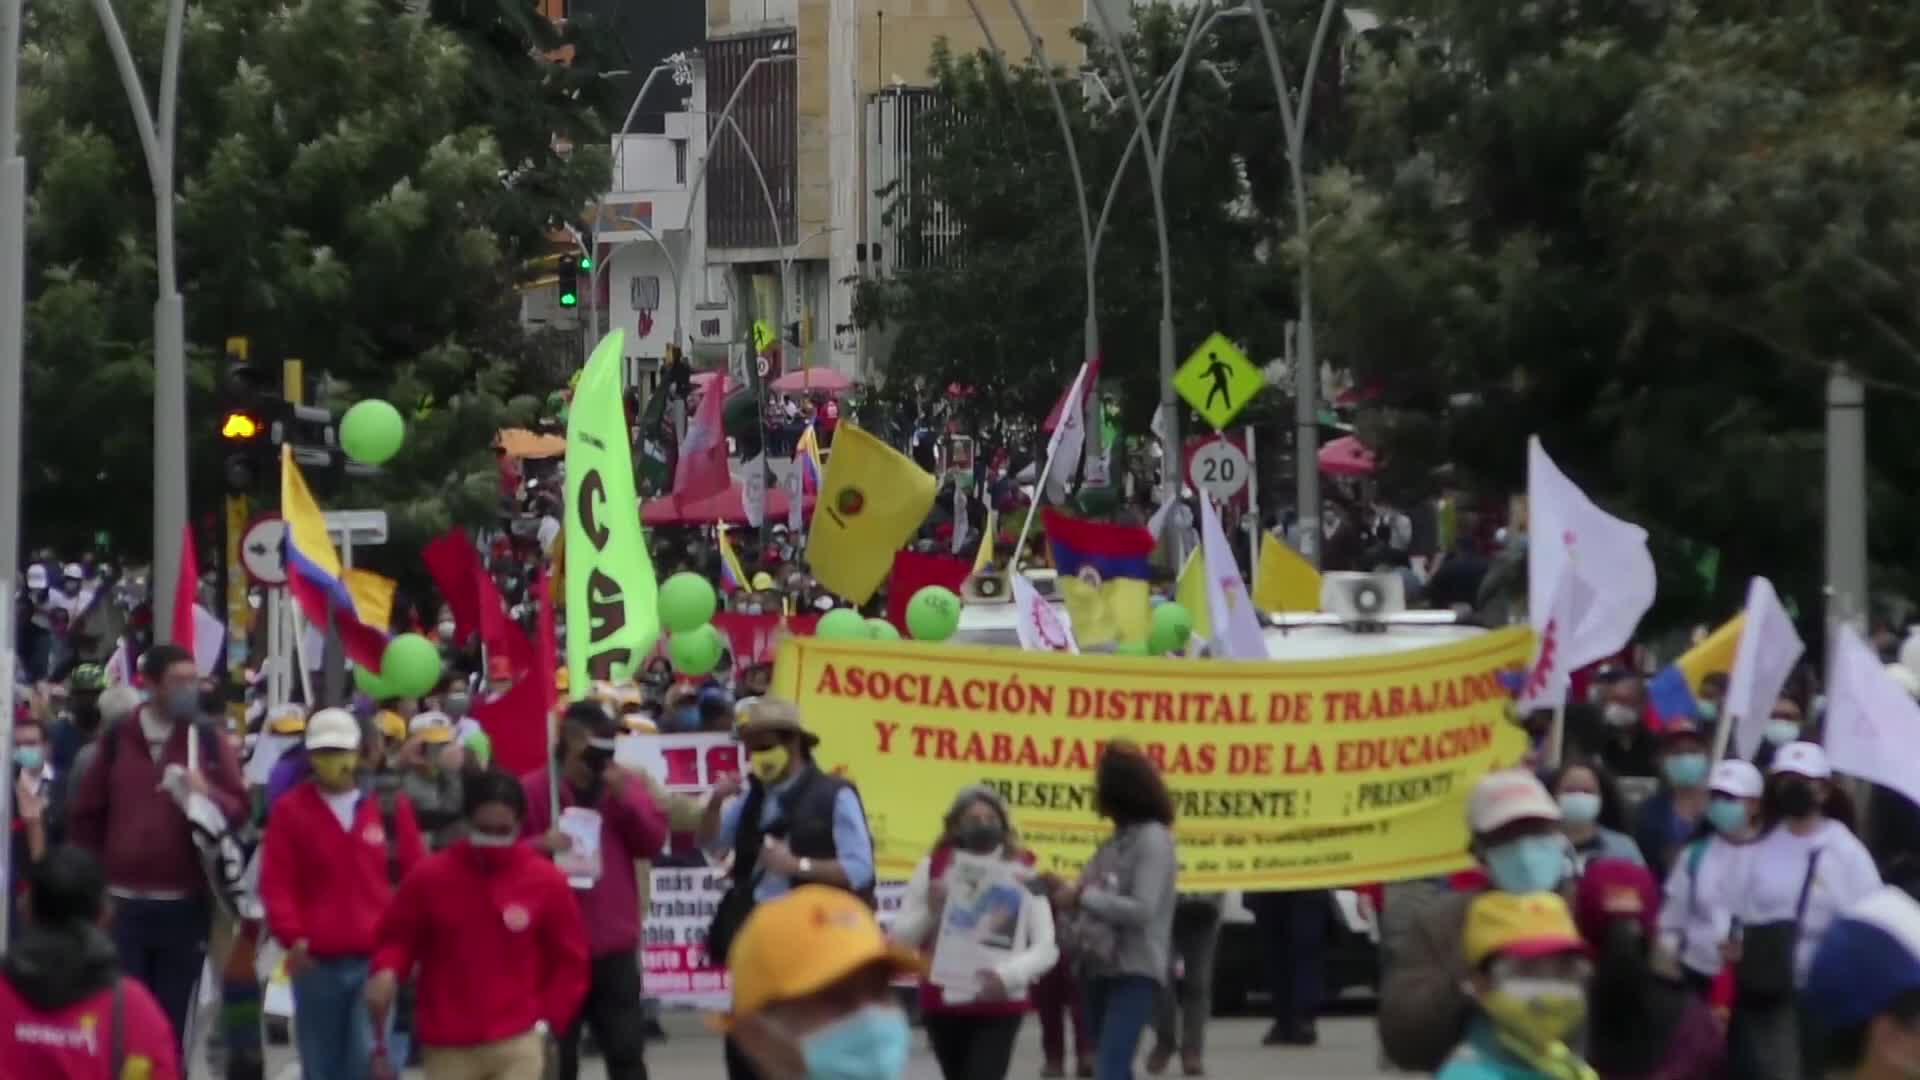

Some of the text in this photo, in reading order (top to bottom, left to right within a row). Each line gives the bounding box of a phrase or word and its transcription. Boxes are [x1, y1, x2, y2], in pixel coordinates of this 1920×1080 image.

[1203, 458, 1234, 483] 20
[816, 663, 1056, 716] ASOCIACIÓN
[1066, 685, 1257, 725] DISTRITAL
[1266, 691, 1314, 725] DE
[875, 720, 1494, 776] Y TRABAJARAS DE LA EDUCACIÓN
[979, 778, 1100, 812] PRESENT
